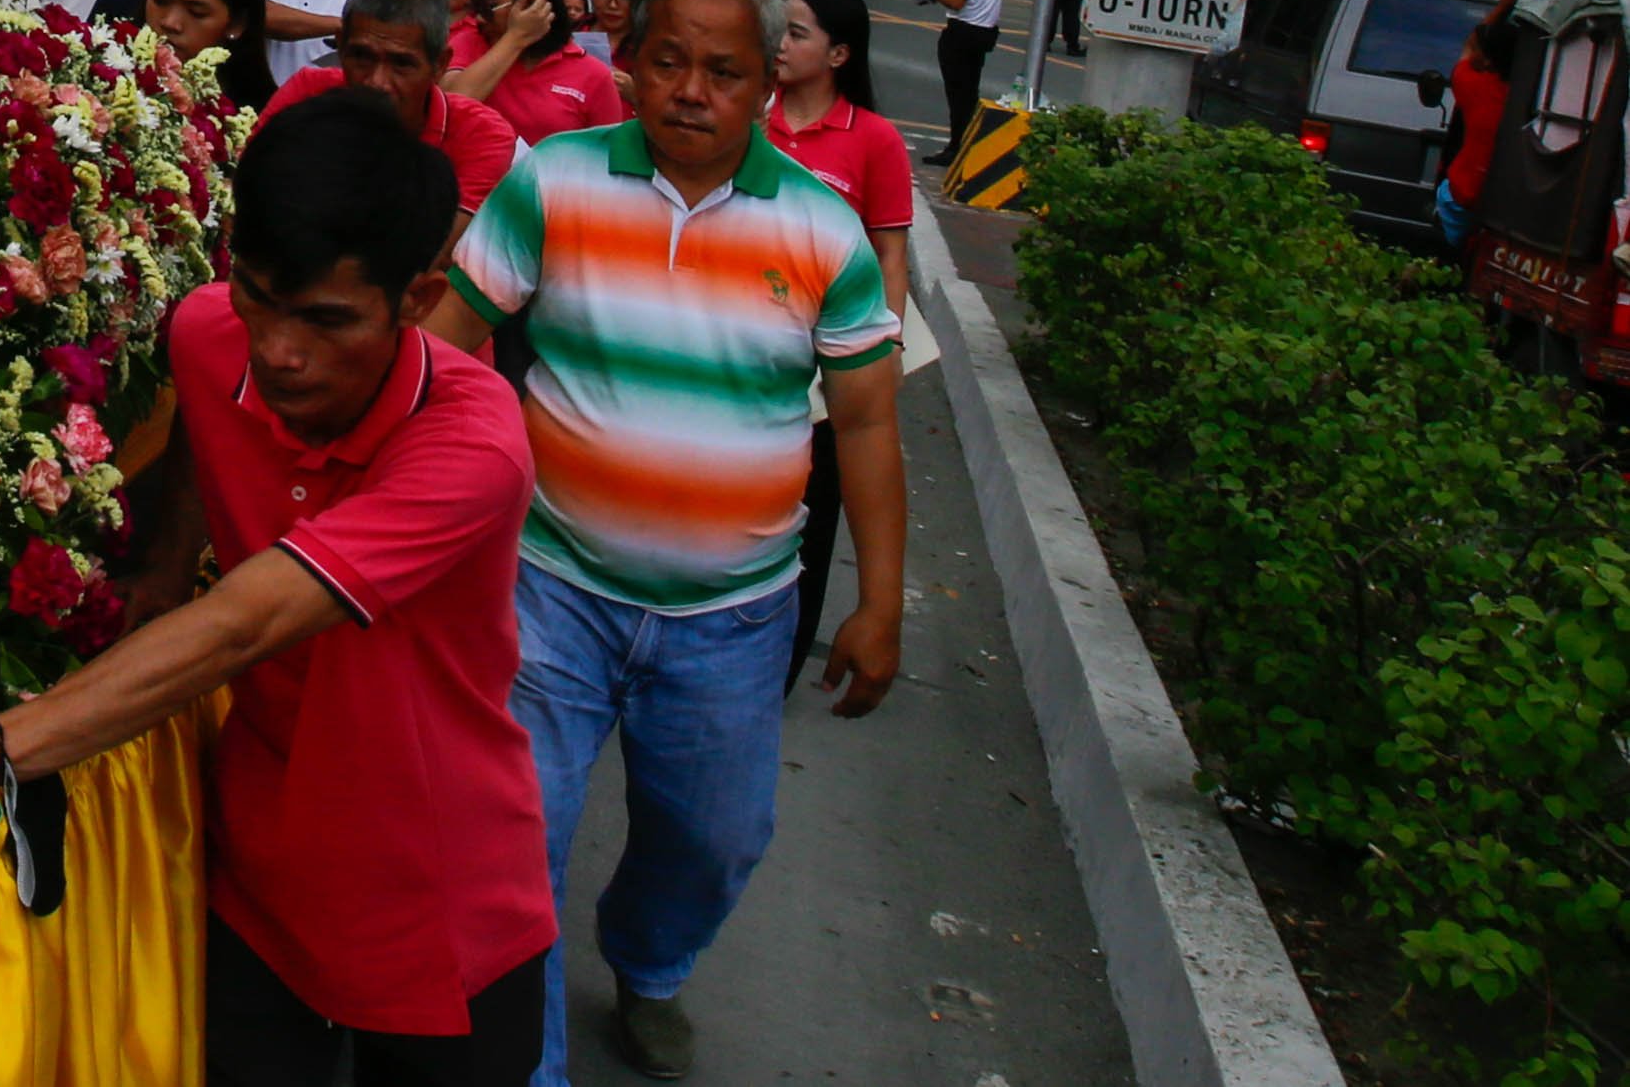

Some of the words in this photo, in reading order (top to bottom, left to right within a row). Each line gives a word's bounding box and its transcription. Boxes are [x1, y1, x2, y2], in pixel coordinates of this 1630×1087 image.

[1128, 23, 1157, 35] MMDA
[1165, 29, 1201, 42] MANILA
[1493, 246, 1587, 293] CHAIOT
